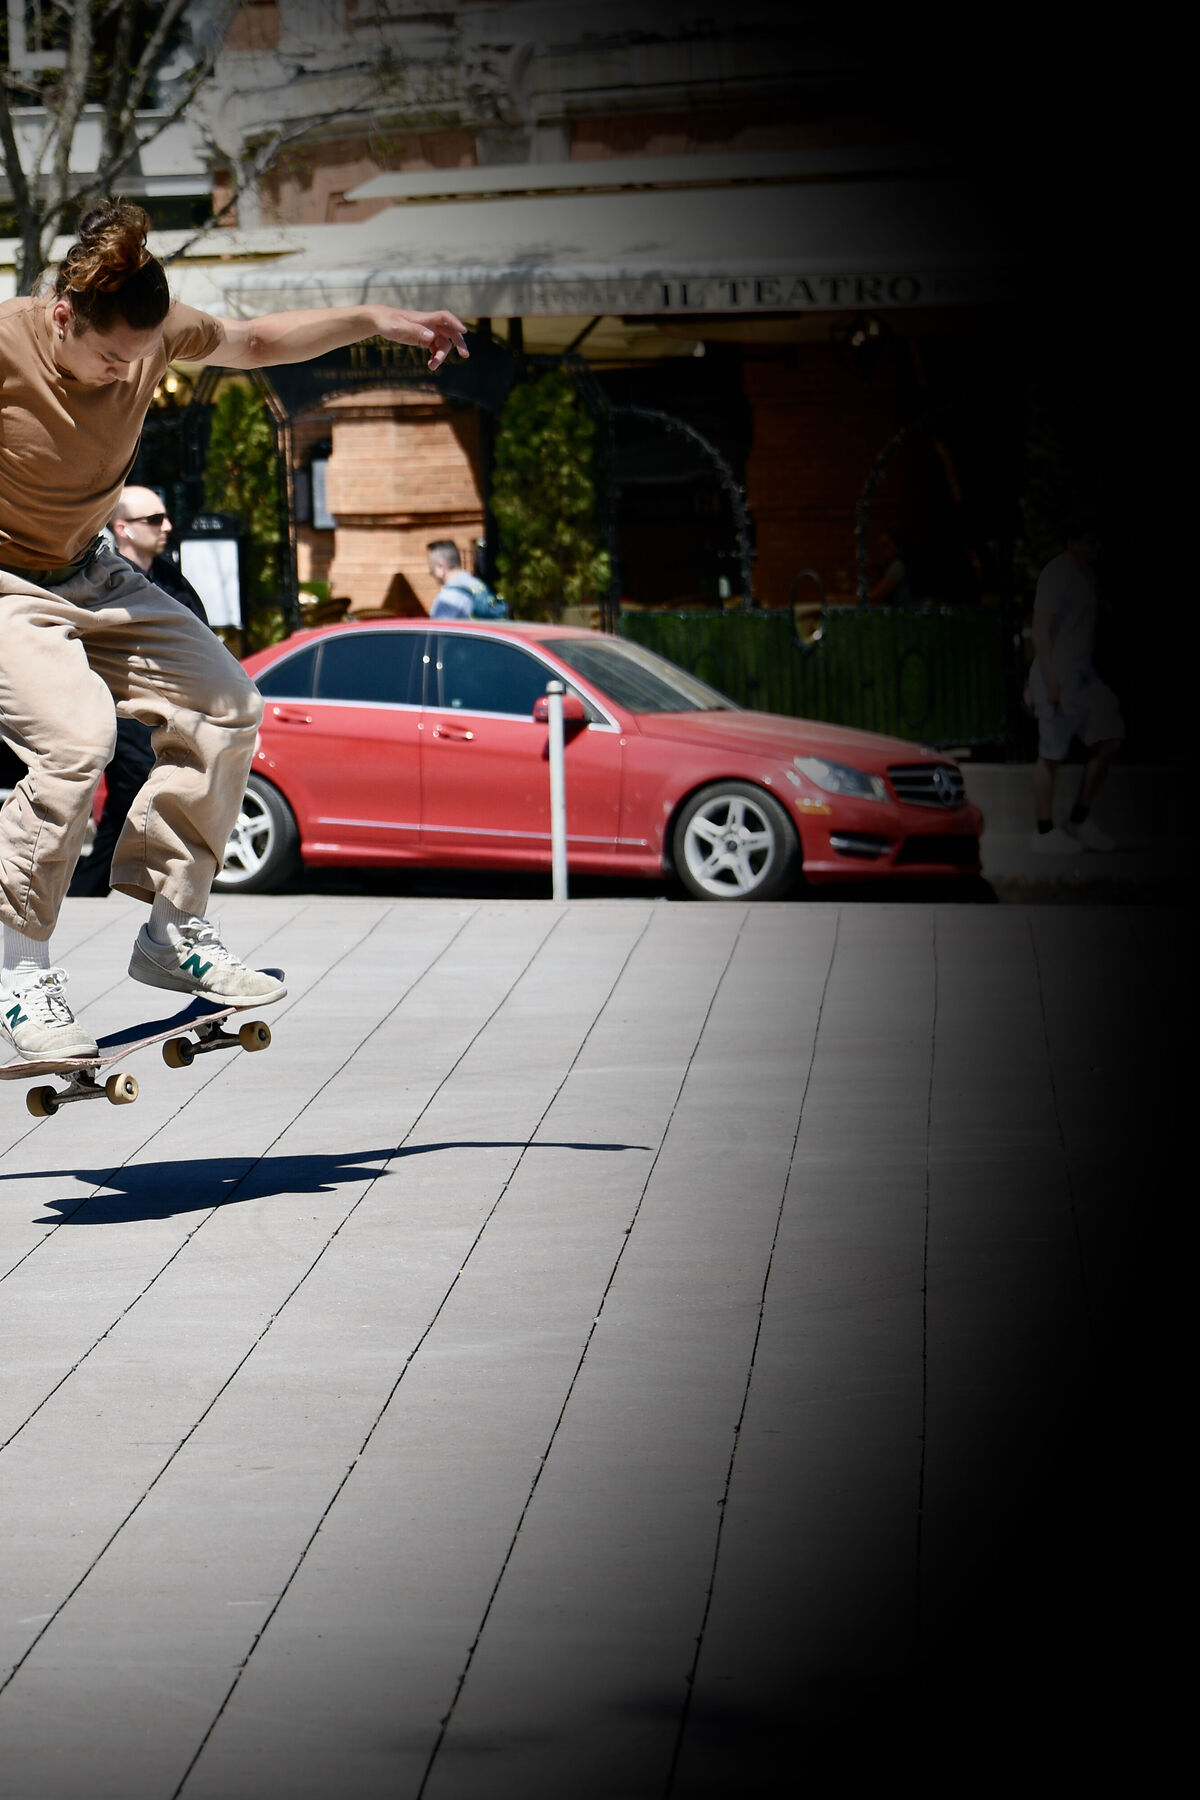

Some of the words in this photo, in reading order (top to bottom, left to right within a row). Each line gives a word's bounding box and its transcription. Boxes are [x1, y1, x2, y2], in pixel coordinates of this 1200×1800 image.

[659, 281, 705, 308] IL
[718, 275, 921, 306] TEATRO
[179, 953, 213, 978] N
[5, 1003, 29, 1029] N
